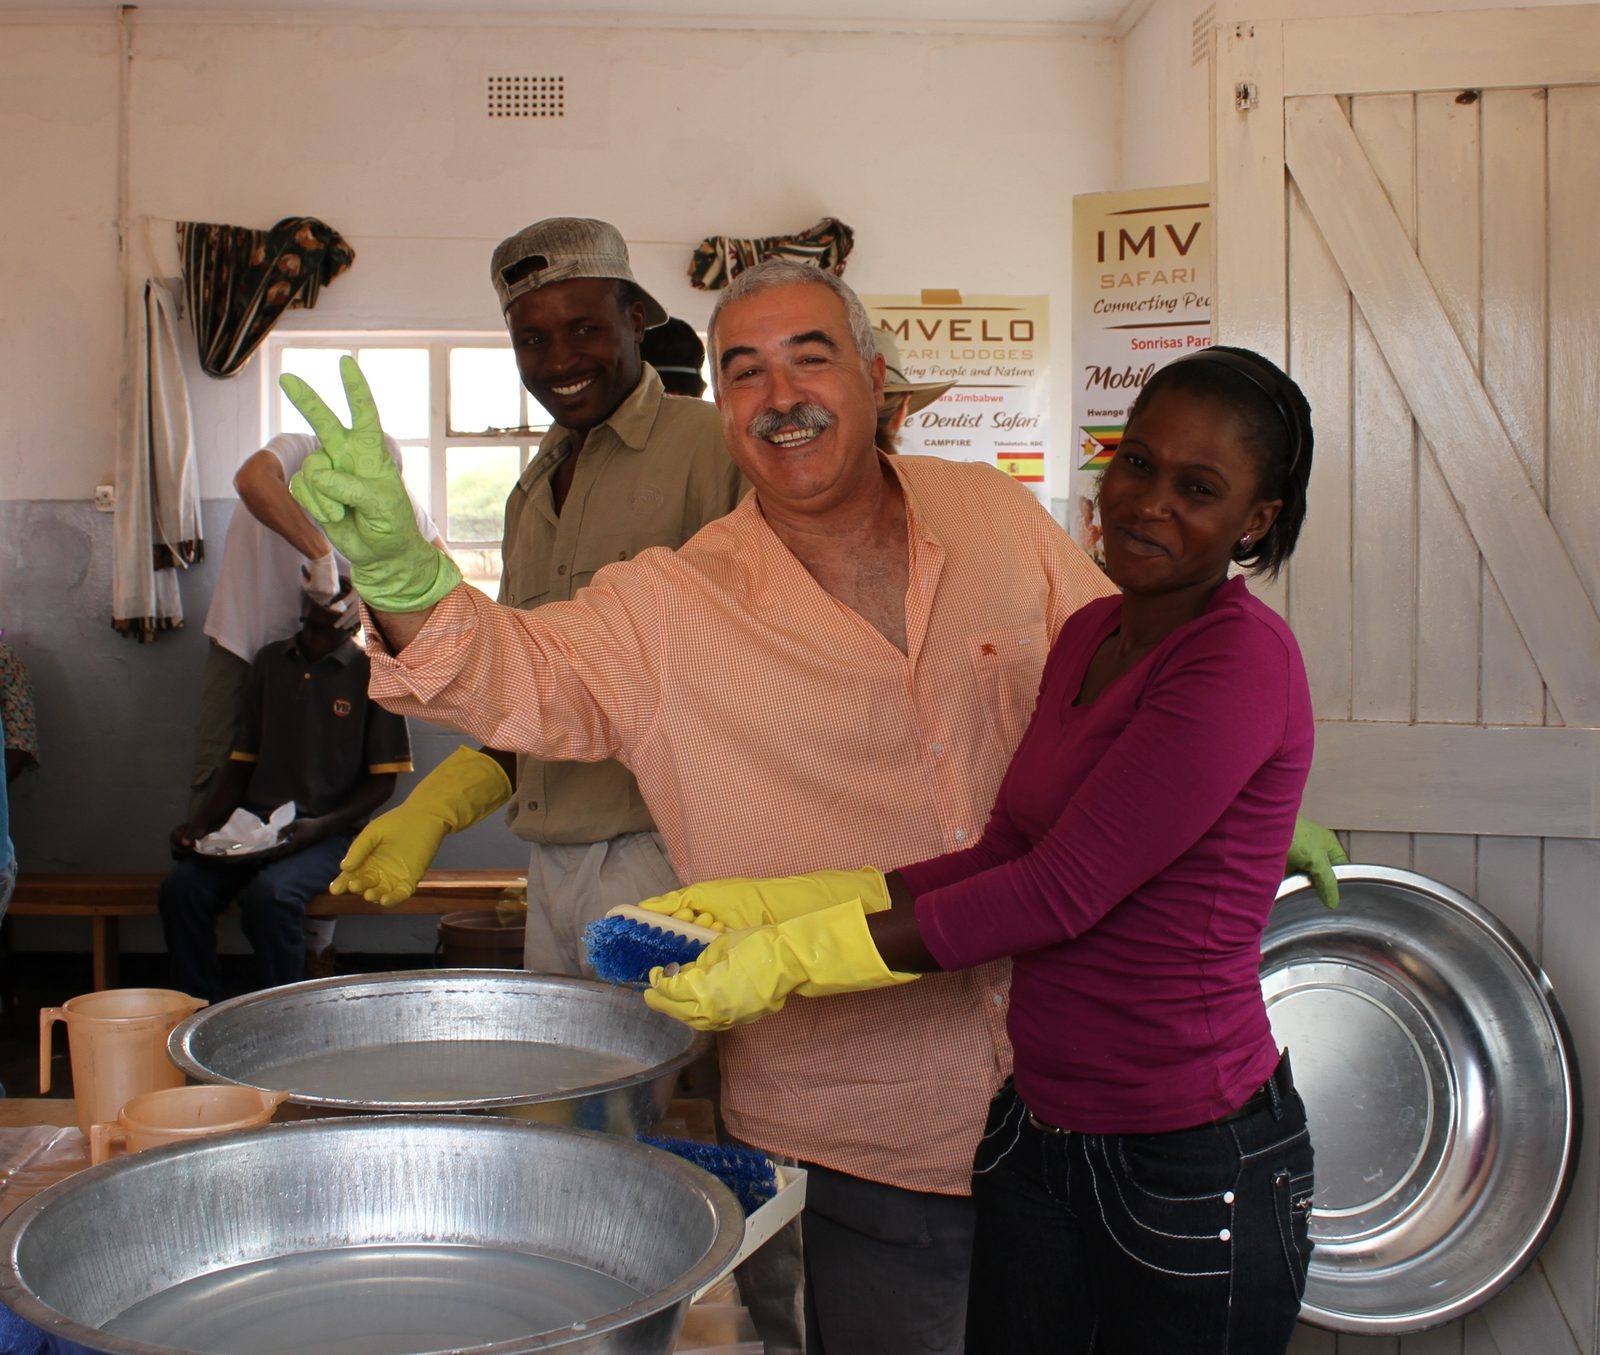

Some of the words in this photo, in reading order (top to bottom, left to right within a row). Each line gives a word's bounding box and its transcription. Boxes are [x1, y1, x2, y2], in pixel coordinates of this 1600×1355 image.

[1097, 222, 1202, 263] IMV
[1100, 267, 1196, 289] SAFARI
[1093, 294, 1178, 314] Connecting
[1131, 337, 1183, 350] Sonrisas
[950, 349, 1034, 360] LODGES
[930, 364, 966, 378] People
[970, 366, 991, 377] and
[995, 366, 1034, 377] Nature
[1085, 363, 1155, 391] Mobil
[955, 393, 1004, 403] Zimbabwe
[1087, 408, 1124, 418] Hwange
[920, 411, 983, 429] Dentist
[990, 411, 1041, 432] Safari
[924, 439, 972, 447] CAMPFIRE
